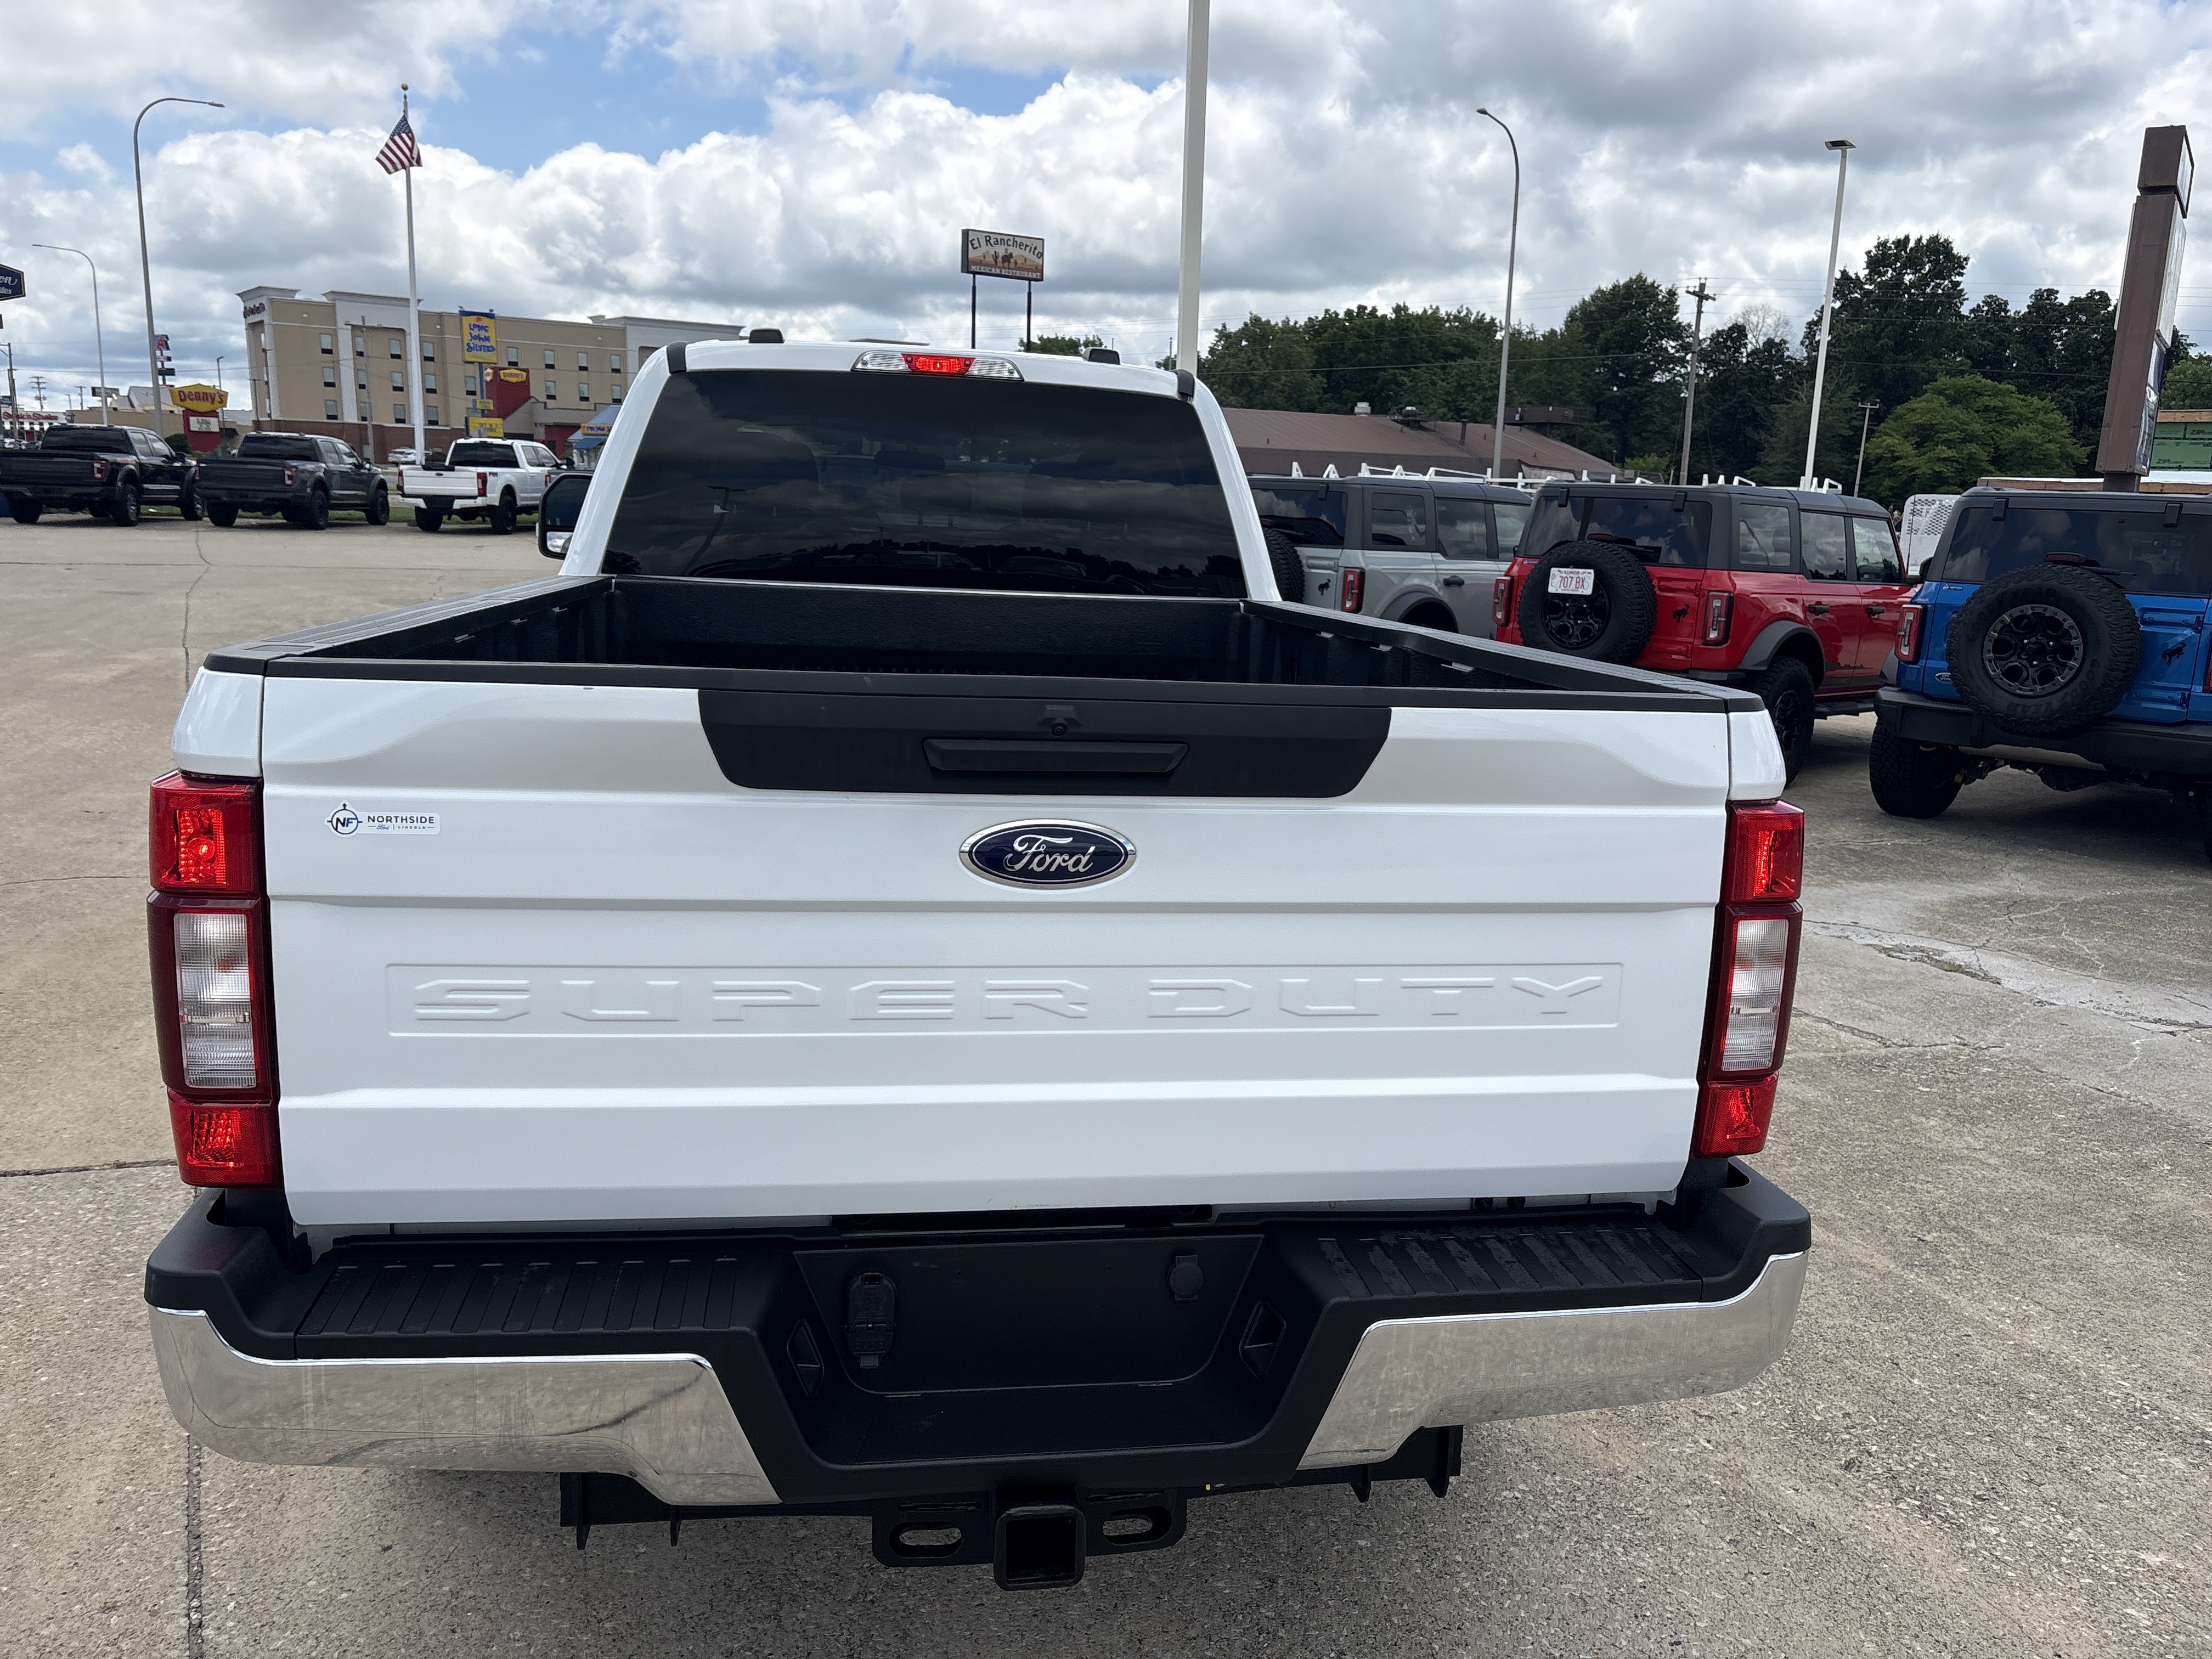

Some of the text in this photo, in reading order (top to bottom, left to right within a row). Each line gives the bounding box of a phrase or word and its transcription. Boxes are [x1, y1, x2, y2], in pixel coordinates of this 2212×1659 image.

[969, 235, 1042, 259] El Rancherito
[178, 390, 224, 405] Denny's
[1559, 575, 1574, 589] 707
[1575, 576, 1586, 590] BX
[335, 817, 358, 832] NF
[368, 815, 435, 824] NORTHSIDE
[1003, 834, 1096, 872] Ford
[414, 977, 1602, 1022] SUPER DUTY
